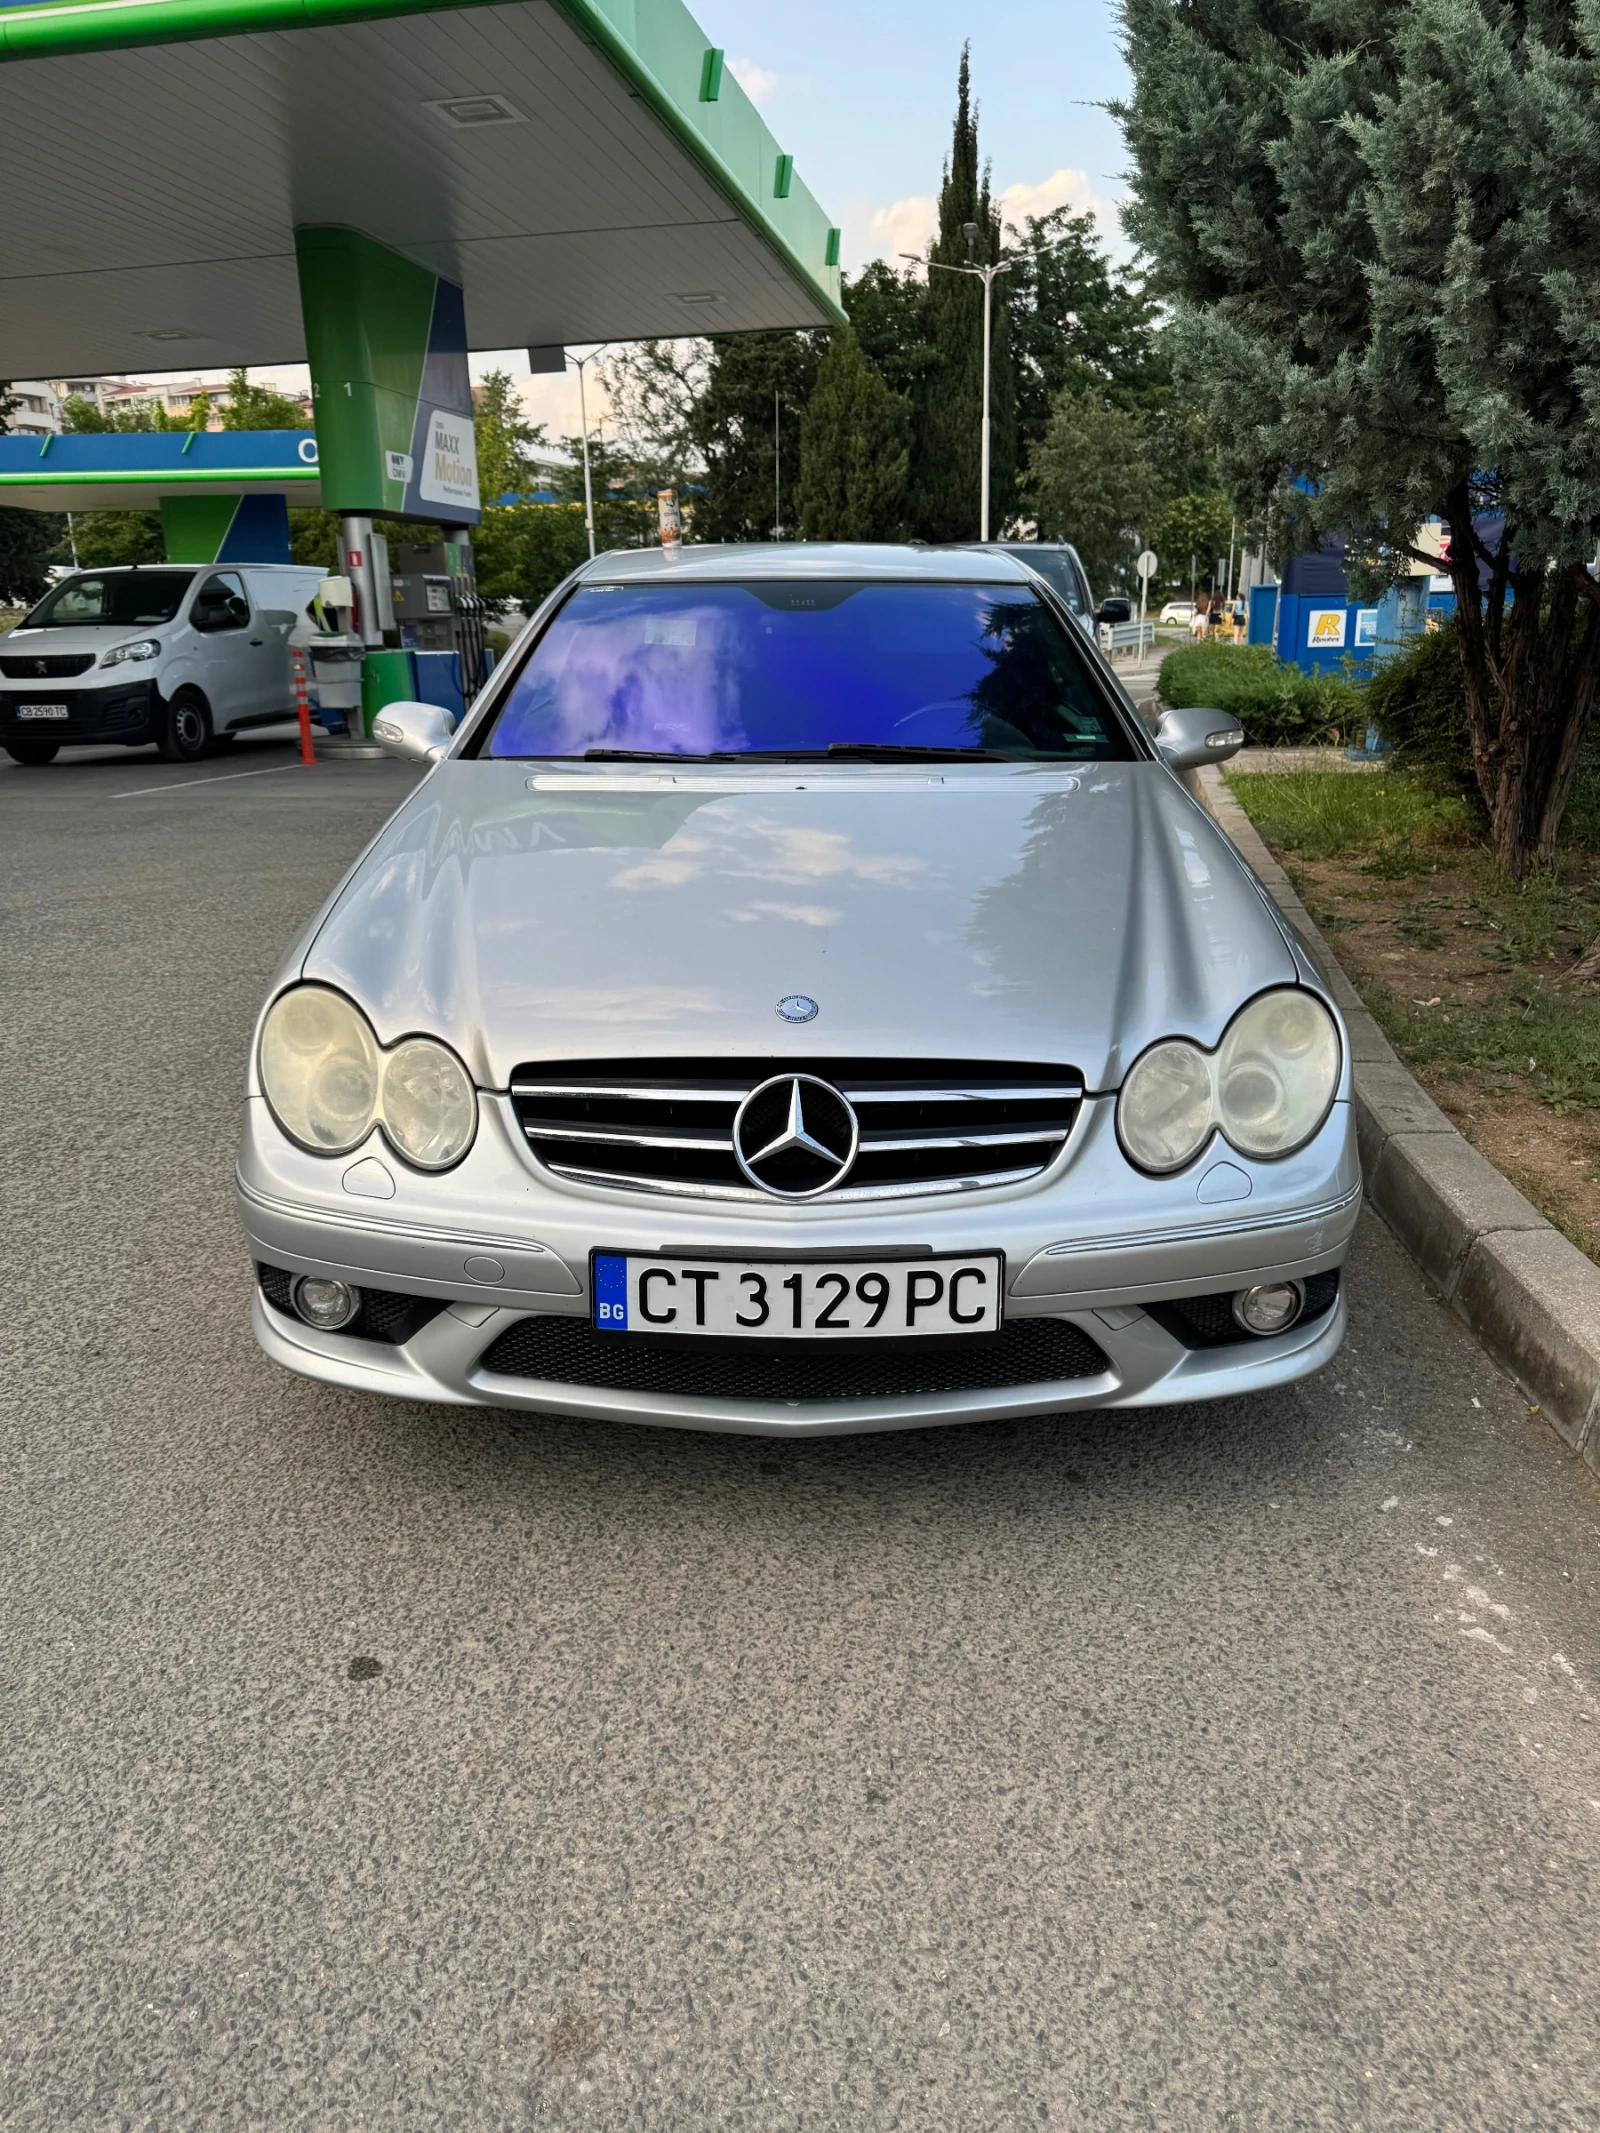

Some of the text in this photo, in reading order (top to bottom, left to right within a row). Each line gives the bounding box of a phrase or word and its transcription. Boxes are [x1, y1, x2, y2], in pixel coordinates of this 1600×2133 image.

[343, 382, 352, 397] 1
[435, 431, 460, 455] MAXX
[435, 453, 472, 487] Motion
[21, 707, 32, 716] CB
[33, 706, 53, 716] 2590
[55, 707, 66, 716] TC
[638, 1267, 986, 1328] CT 3129 PC
[599, 1303, 624, 1320] BG
